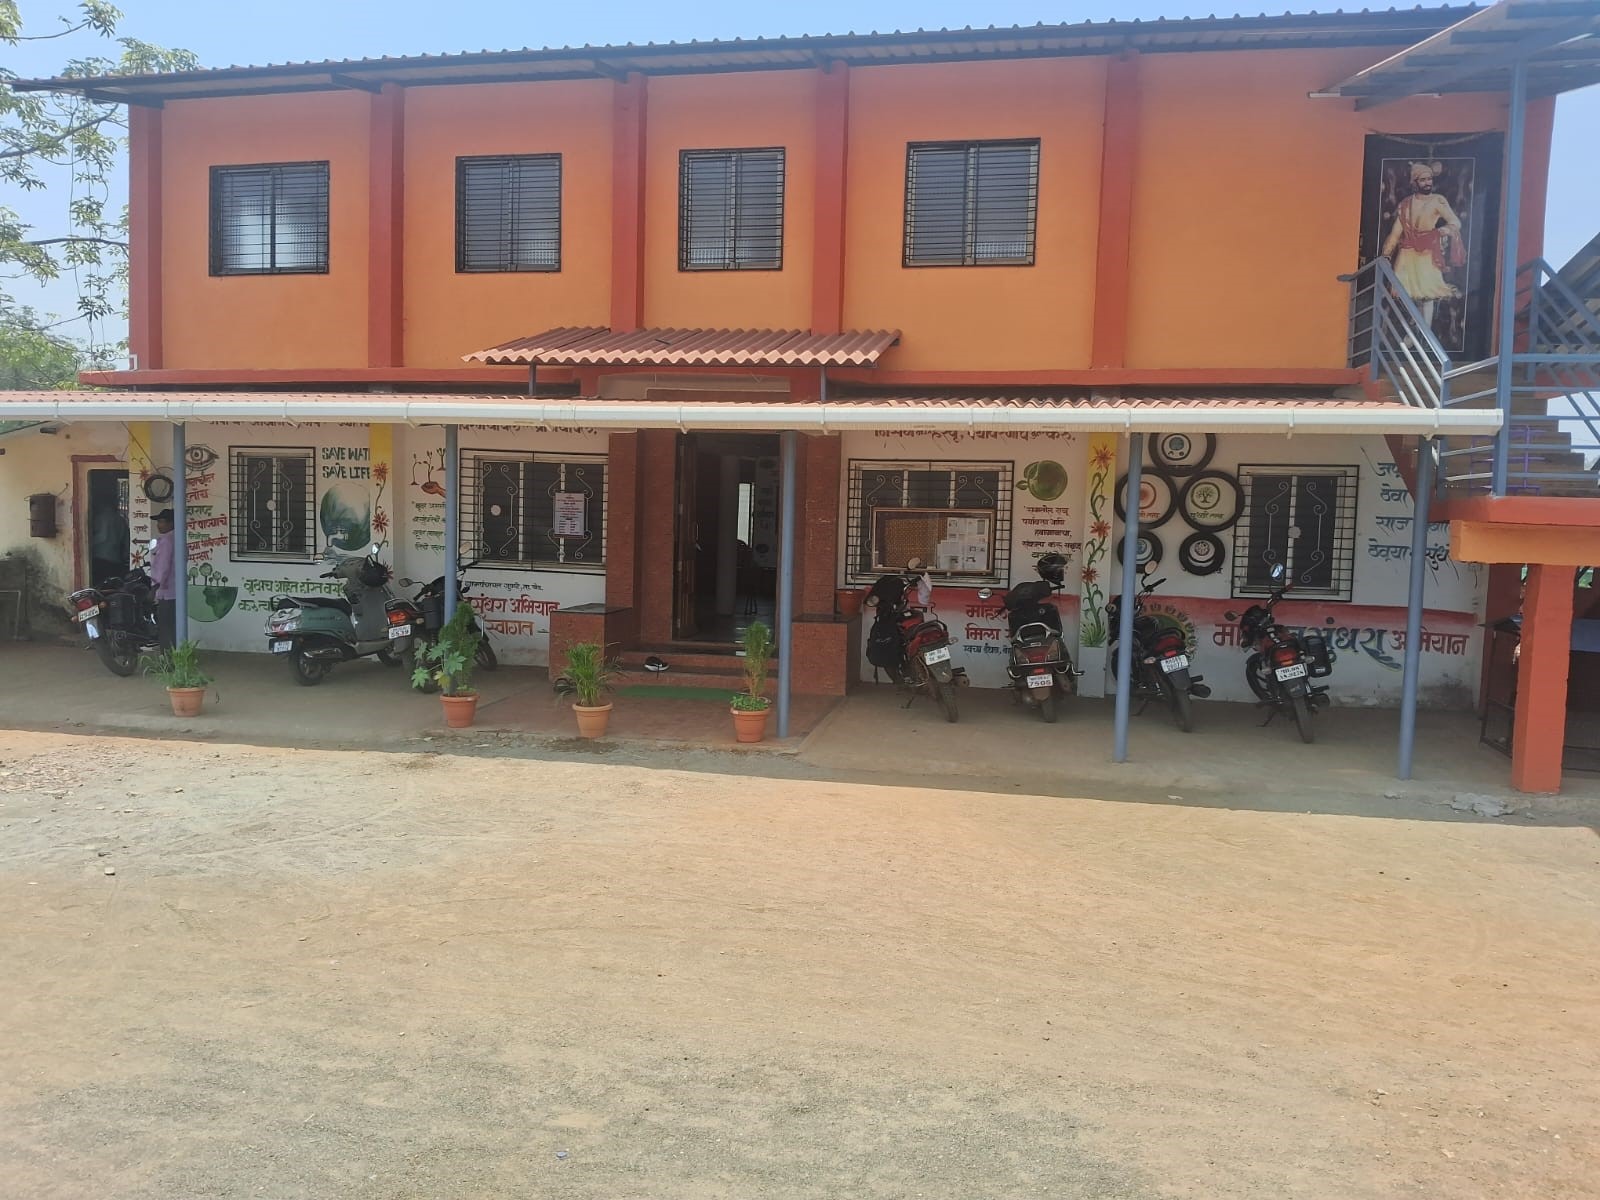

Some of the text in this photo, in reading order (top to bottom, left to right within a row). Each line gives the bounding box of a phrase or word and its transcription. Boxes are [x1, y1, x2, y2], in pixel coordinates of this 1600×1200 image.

[322, 447, 370, 461] SAVE WAT
[322, 465, 347, 479] SAVE
[485, 619, 535, 636] स्वागत
